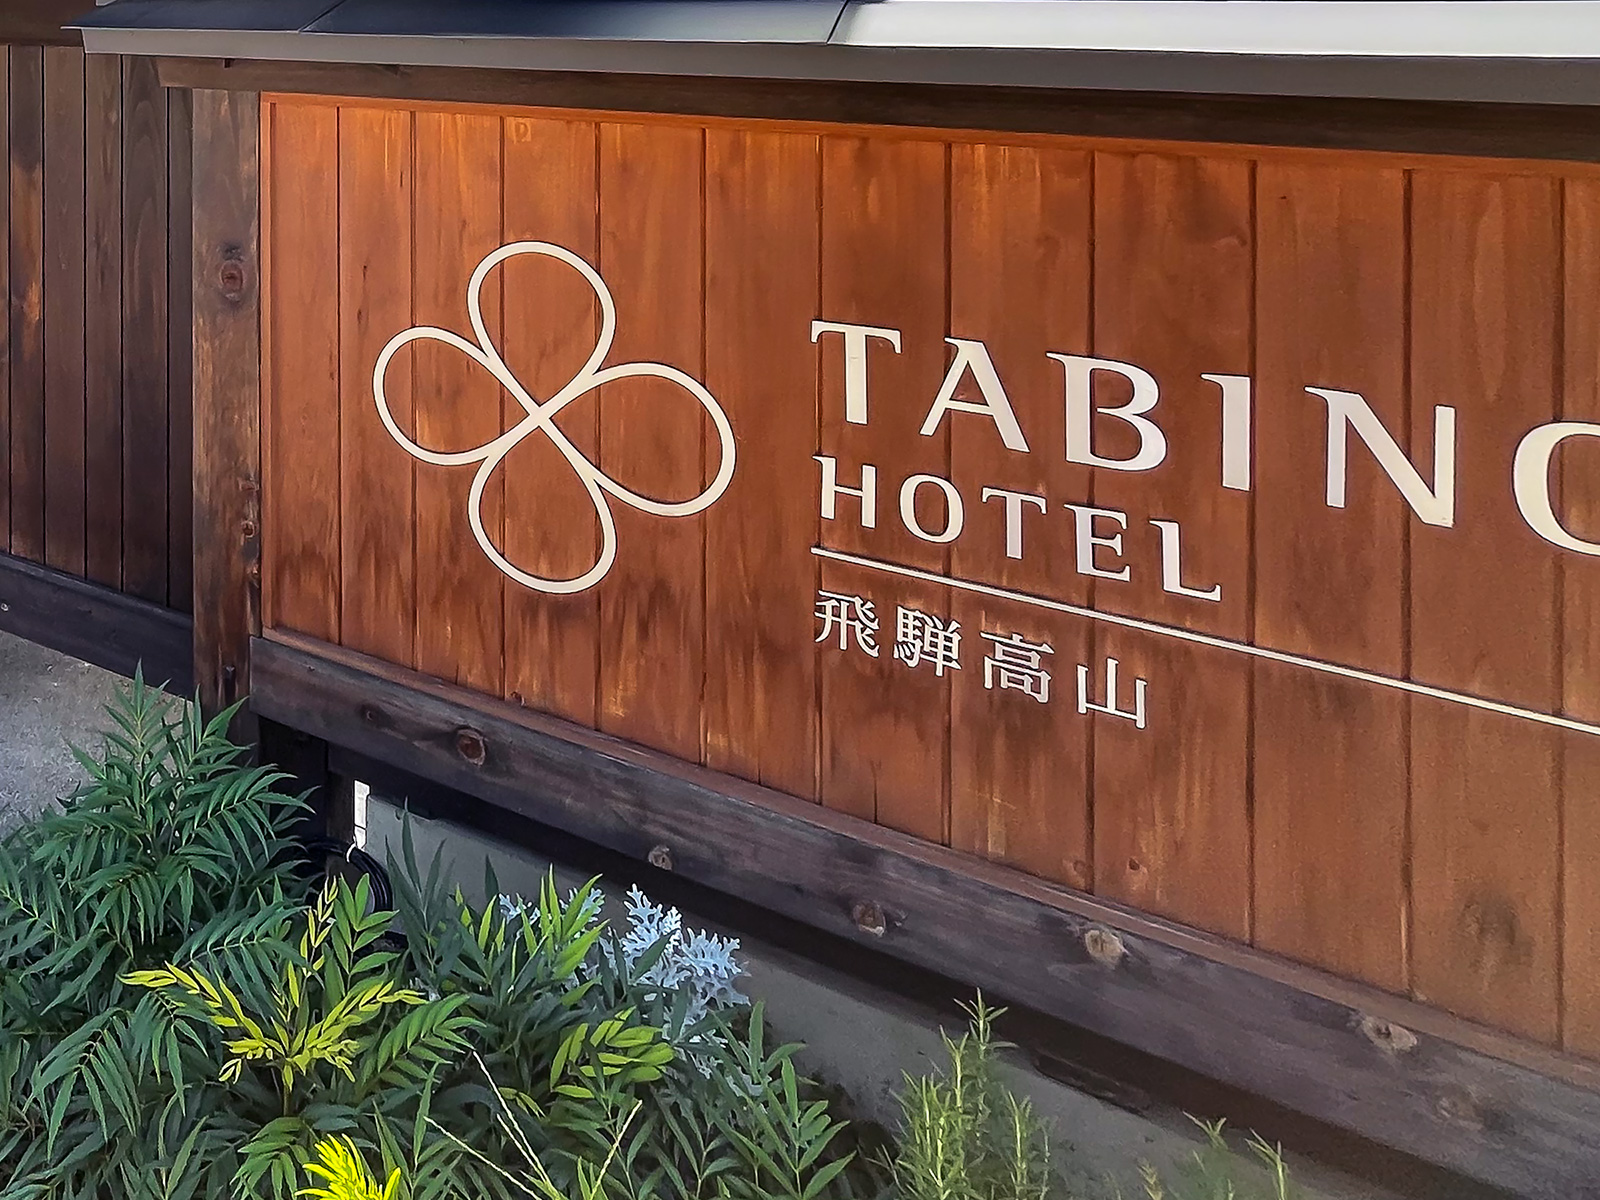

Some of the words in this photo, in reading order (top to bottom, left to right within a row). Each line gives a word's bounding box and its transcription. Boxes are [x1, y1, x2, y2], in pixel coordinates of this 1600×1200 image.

[812, 455, 1222, 603] HOTEL
[813, 589, 1149, 730] 飛騨高山
